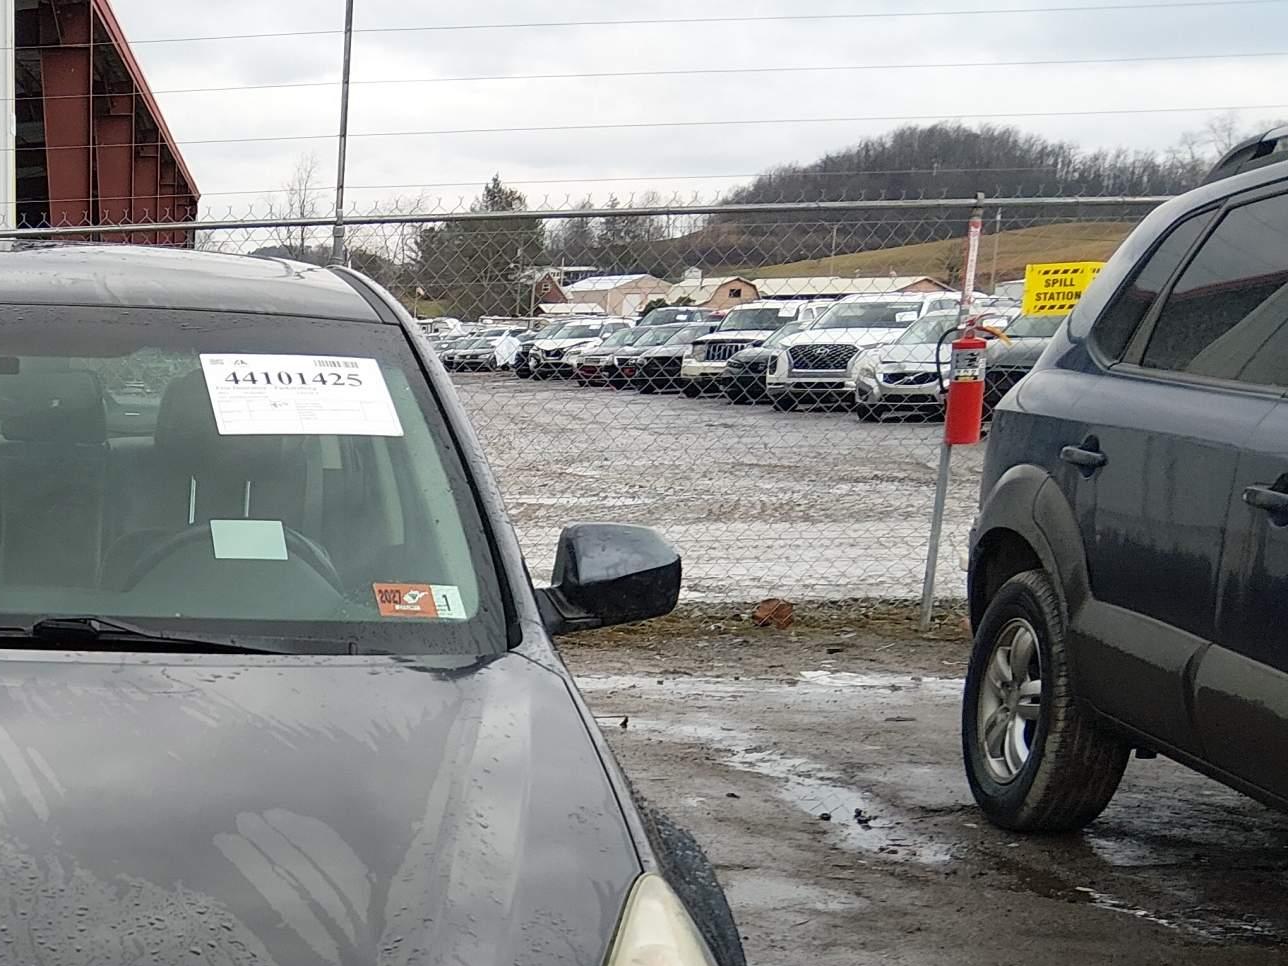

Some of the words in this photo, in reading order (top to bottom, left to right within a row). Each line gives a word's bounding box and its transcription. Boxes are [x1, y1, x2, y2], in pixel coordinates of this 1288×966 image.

[1044, 278, 1076, 288] SPILL
[1035, 291, 1082, 301] STATION
[224, 370, 363, 387] 44101425
